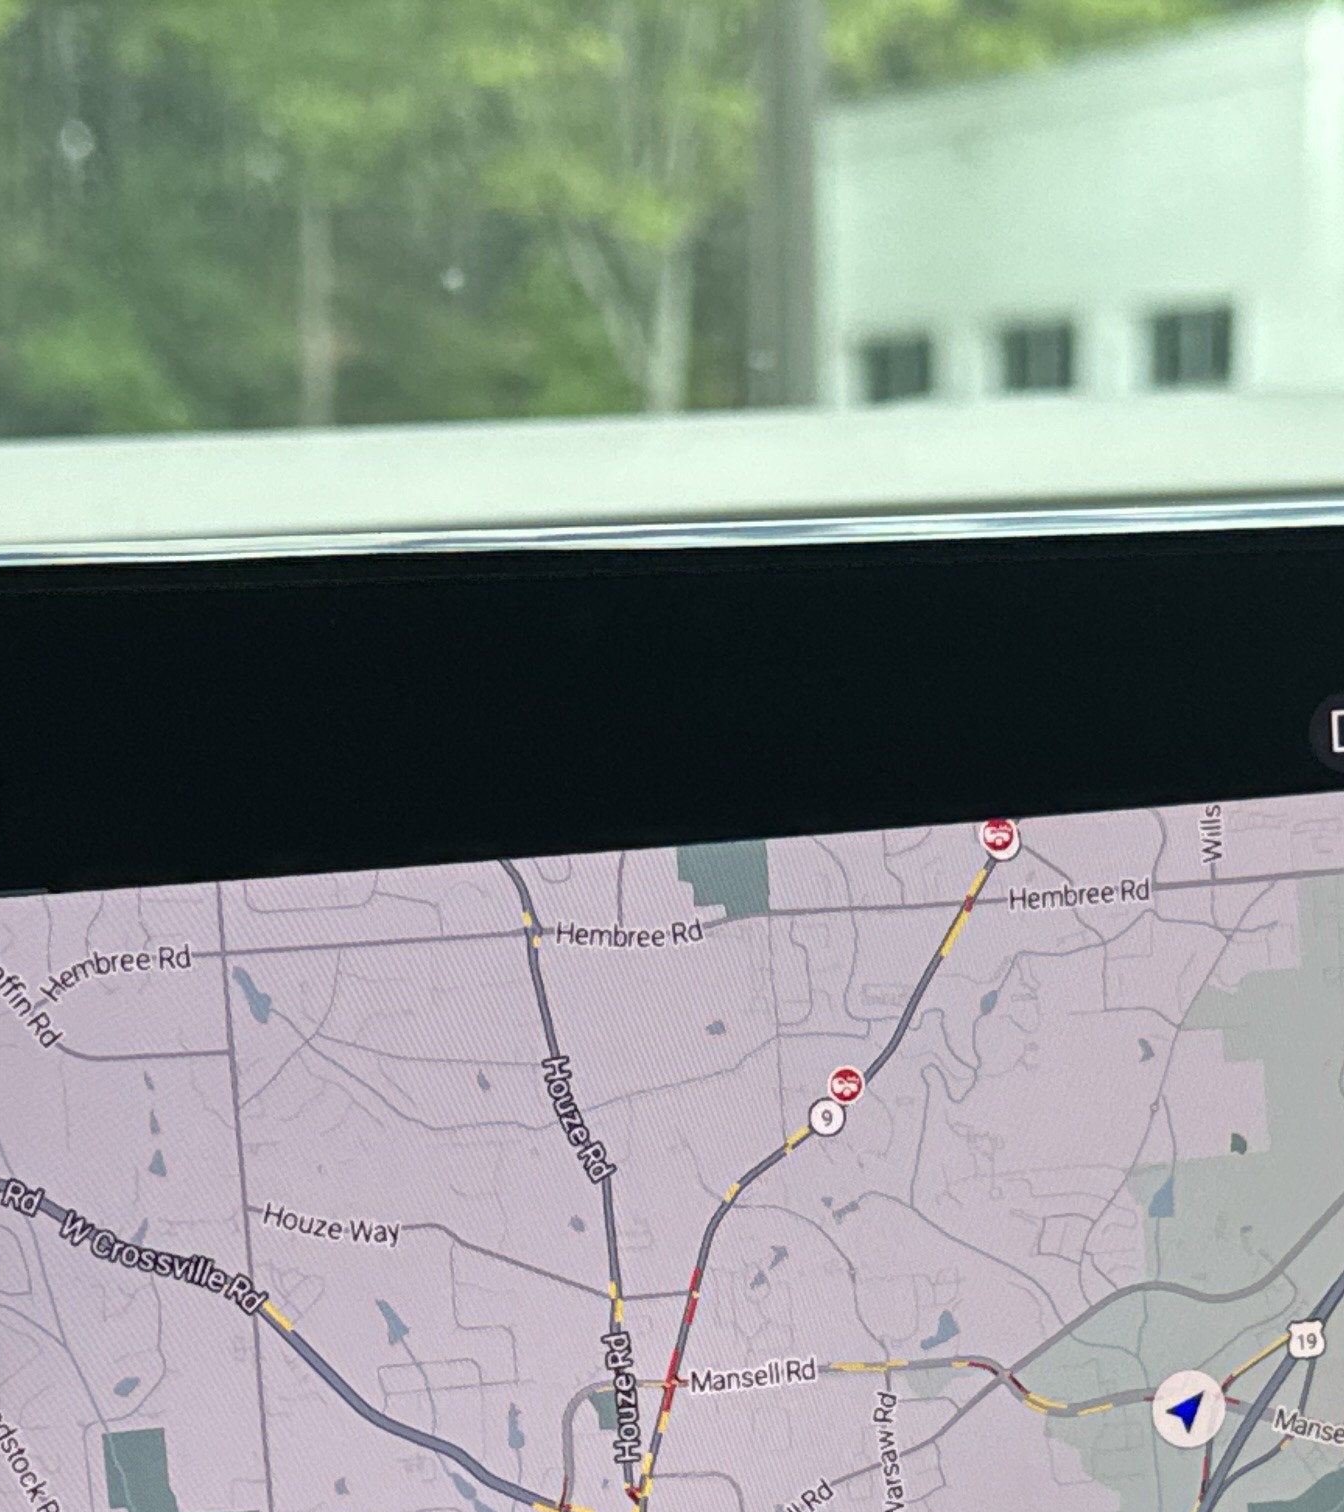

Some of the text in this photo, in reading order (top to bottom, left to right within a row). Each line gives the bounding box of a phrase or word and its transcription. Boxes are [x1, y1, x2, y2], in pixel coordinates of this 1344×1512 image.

[1200, 804, 1222, 863] Wills
[1008, 881, 1150, 911] Hembree Rd
[556, 922, 703, 948] Hembree Rd
[40, 945, 191, 1002] Hembree Rd
[27, 1010, 59, 1049] Rd
[542, 1058, 616, 1183] Houze Rd
[821, 1108, 833, 1126] 9
[0, 1178, 45, 1217] Rd
[263, 1203, 400, 1248] Houze Way
[60, 1209, 266, 1313] W Crossville Rd
[1297, 1333, 1317, 1350] 19
[691, 1359, 816, 1392] Mansell Rd
[601, 1331, 642, 1463] Houze Rd
[873, 1391, 898, 1423] Rd
